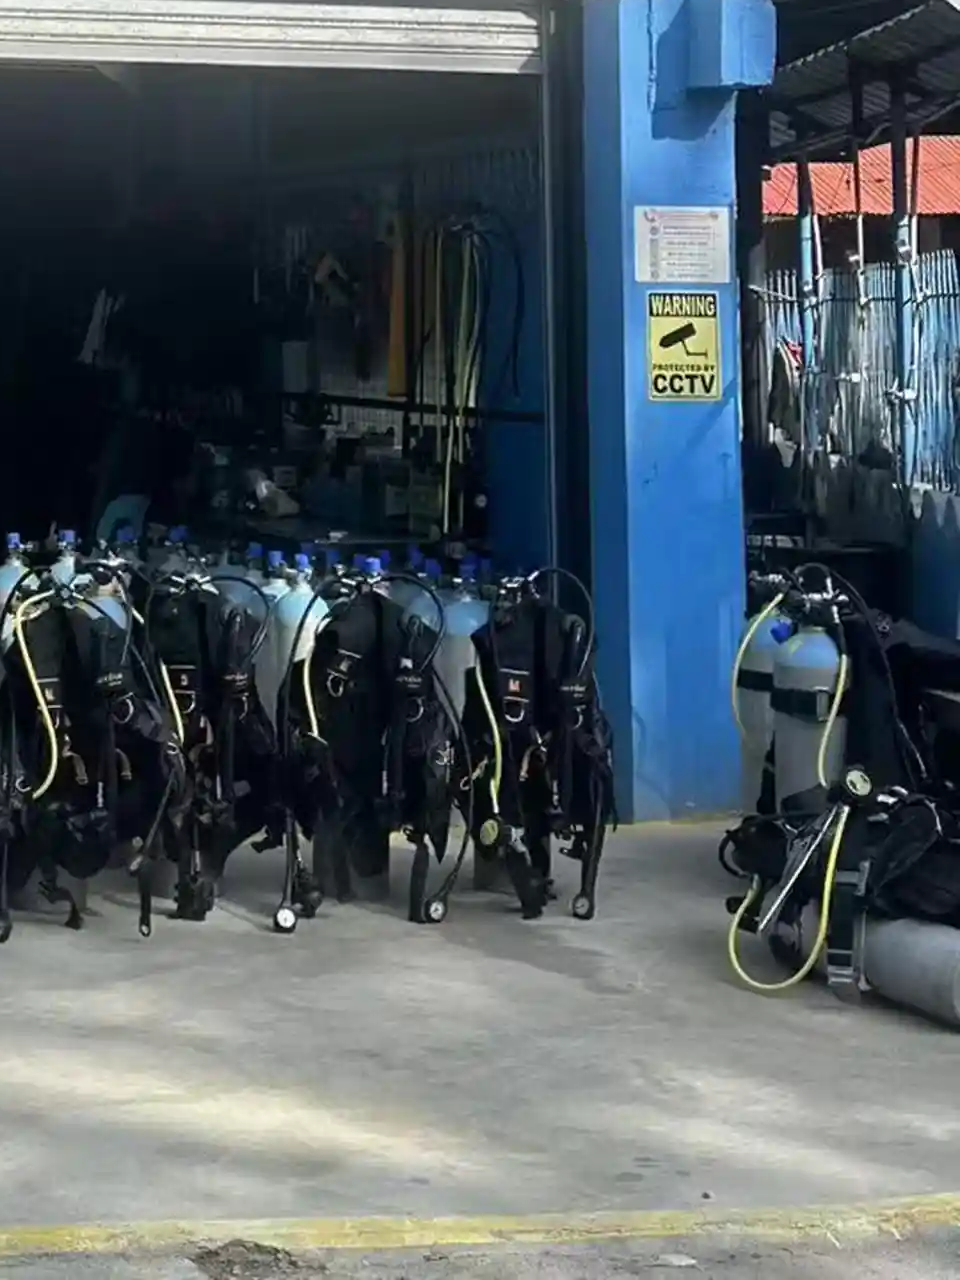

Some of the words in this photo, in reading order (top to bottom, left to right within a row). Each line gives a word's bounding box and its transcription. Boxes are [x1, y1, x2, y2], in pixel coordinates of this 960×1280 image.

[651, 295, 715, 317] WARNING
[652, 363, 702, 372] PROTECTED
[703, 363, 715, 372] BY
[653, 373, 716, 394] CCTV
